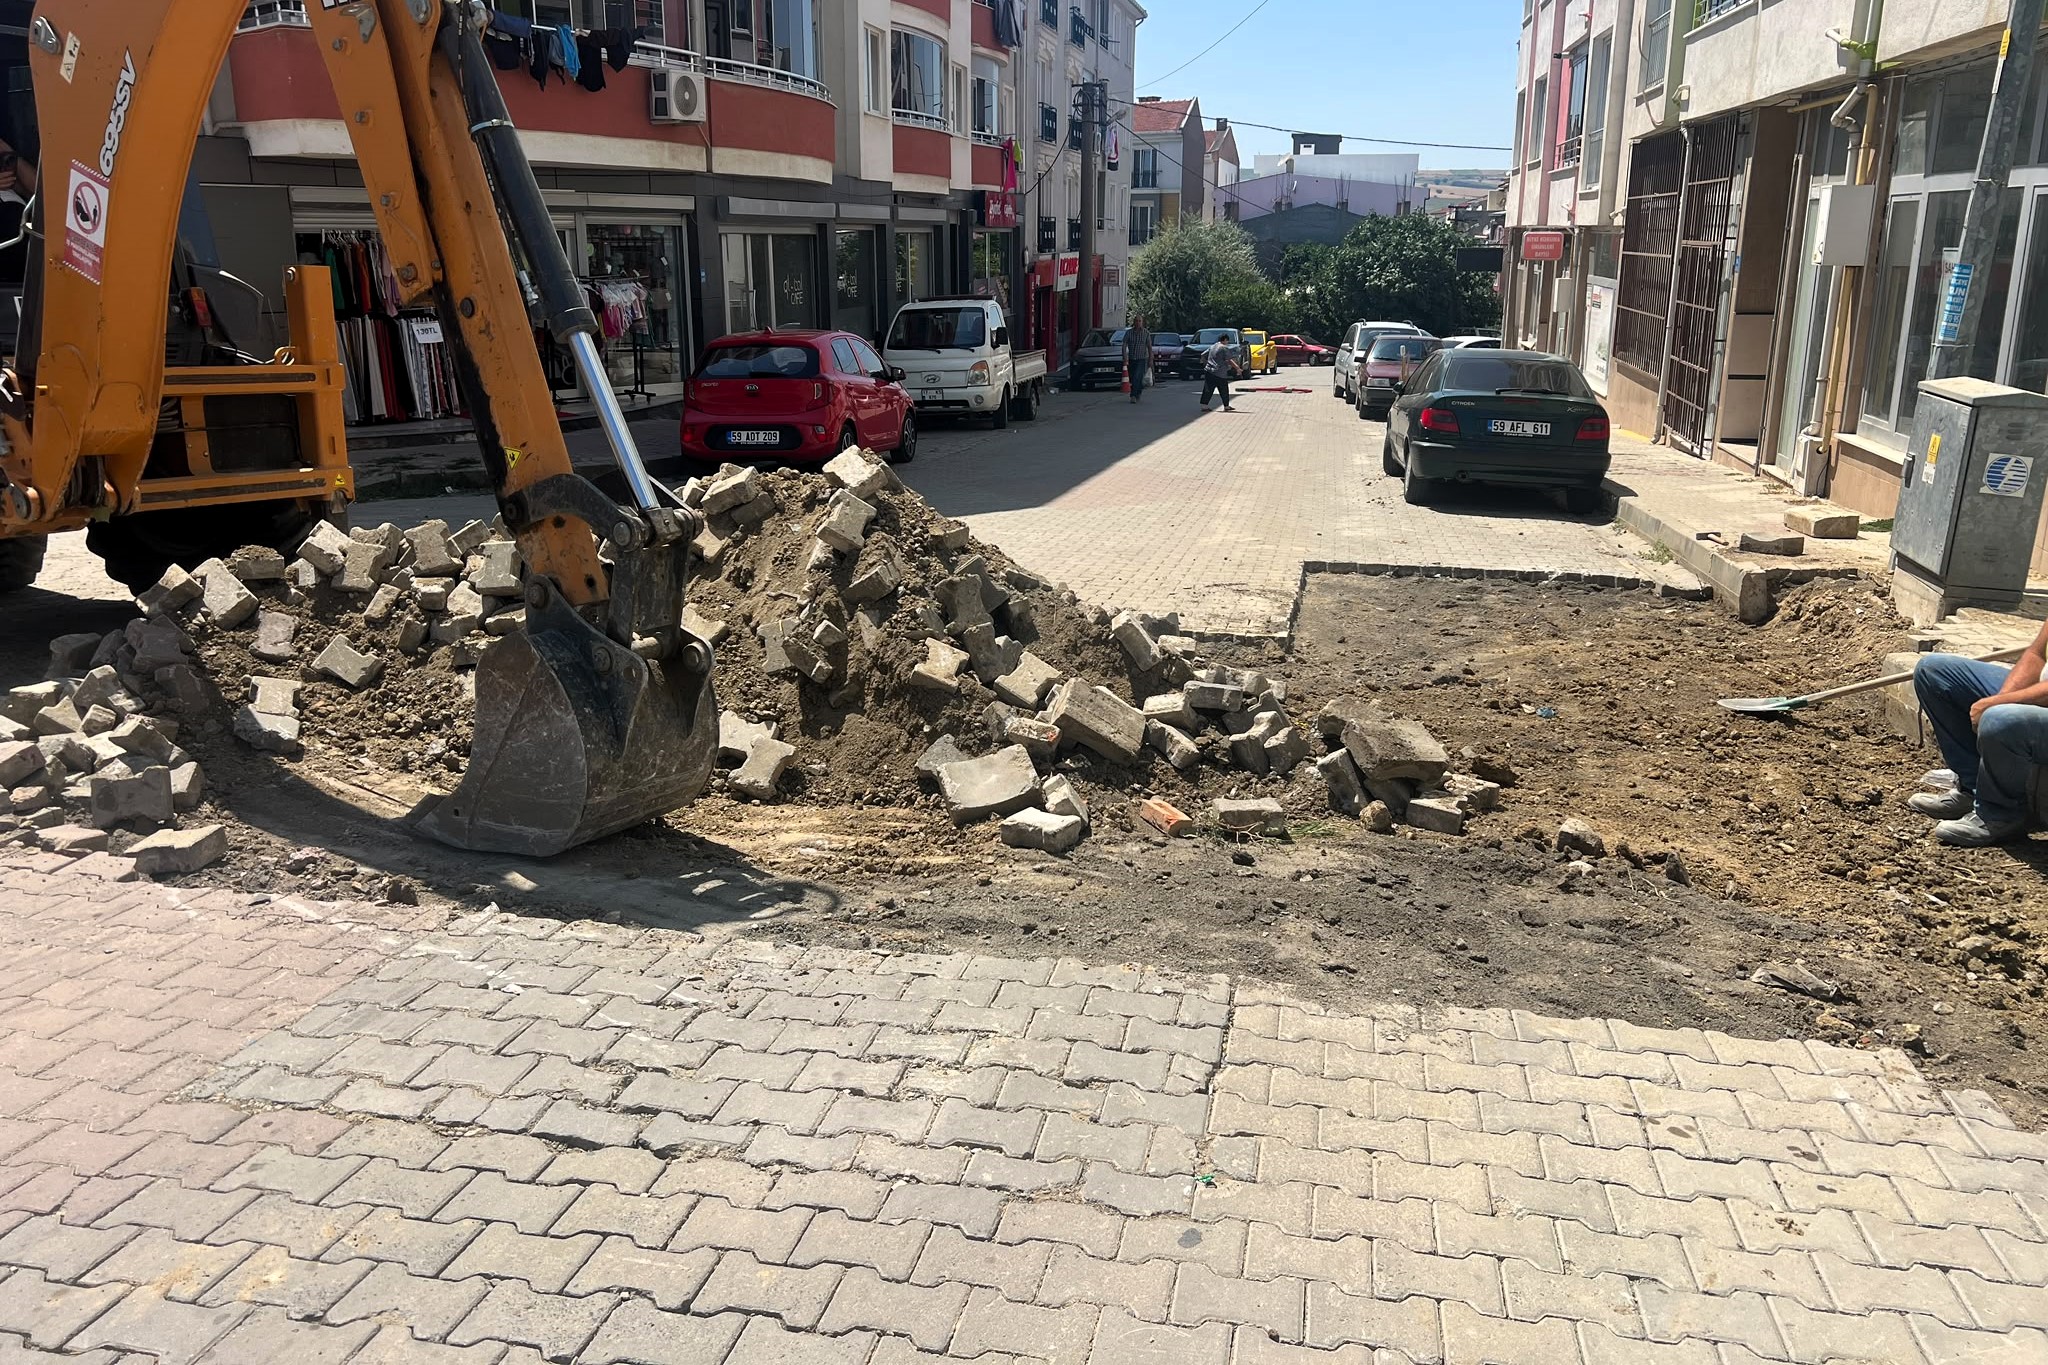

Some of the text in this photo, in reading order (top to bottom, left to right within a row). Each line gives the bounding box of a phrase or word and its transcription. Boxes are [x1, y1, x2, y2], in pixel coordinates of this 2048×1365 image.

[100, 47, 136, 177] 695SV
[1493, 421, 1506, 431] 59
[1509, 423, 1528, 433] AFL
[1532, 424, 1549, 435] 611
[732, 432, 778, 441] 59 ADT 209
